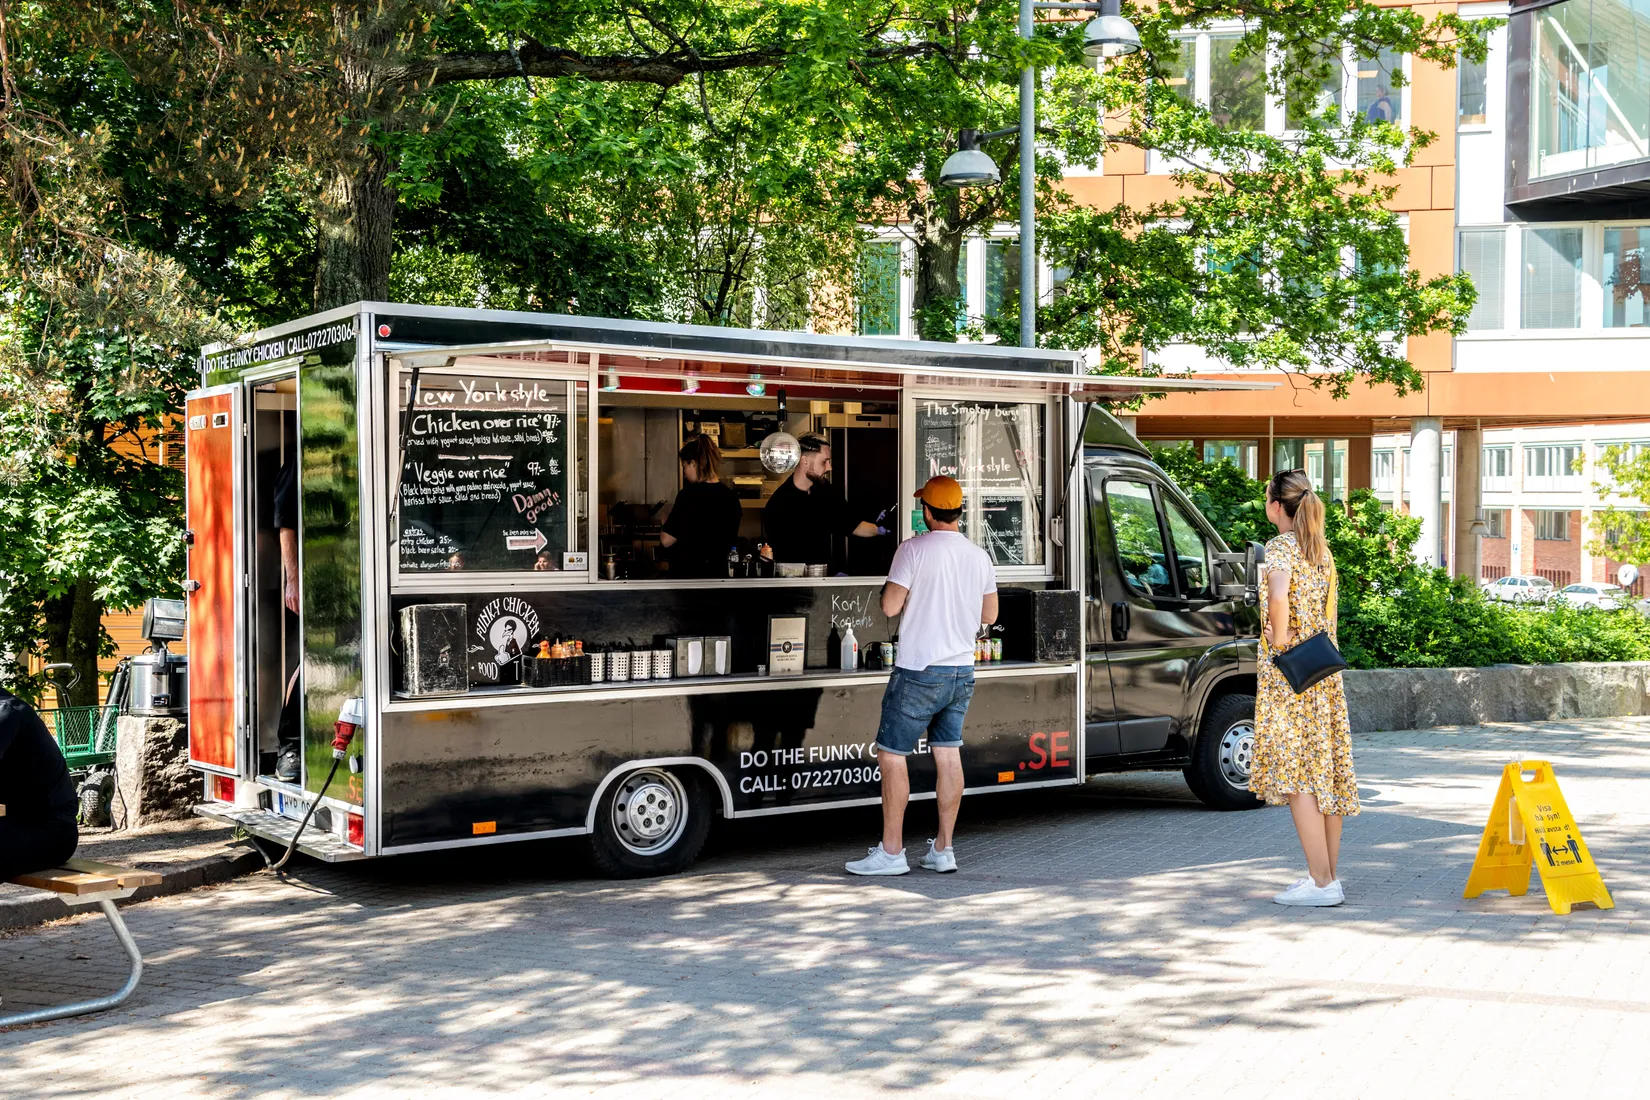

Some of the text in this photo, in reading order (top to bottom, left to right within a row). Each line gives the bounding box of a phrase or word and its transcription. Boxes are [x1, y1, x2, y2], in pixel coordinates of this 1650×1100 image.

[206, 357, 216, 374] DO
[217, 354, 230, 372] THE
[229, 349, 253, 369] FUNKY
[253, 340, 285, 362] CHICKEN
[405, 378, 550, 407] New York style
[412, 412, 481, 435] Chicken
[483, 418, 514, 429] over
[923, 401, 949, 418] The
[951, 401, 991, 421] Smokey
[458, 469, 480, 479] over
[930, 458, 958, 476] New
[959, 457, 985, 474] York
[986, 456, 1011, 475] style
[511, 488, 551, 513] Damn
[476, 596, 540, 642] FUNKY CHICKEN
[477, 661, 498, 680] FOOD
[740, 750, 768, 769] DO
[771, 748, 804, 766] THE
[809, 742, 866, 763] FUNKY
[1018, 730, 1070, 771] .SE
[740, 765, 882, 794] CALL: 072270306
[1537, 804, 1552, 812] Visa
